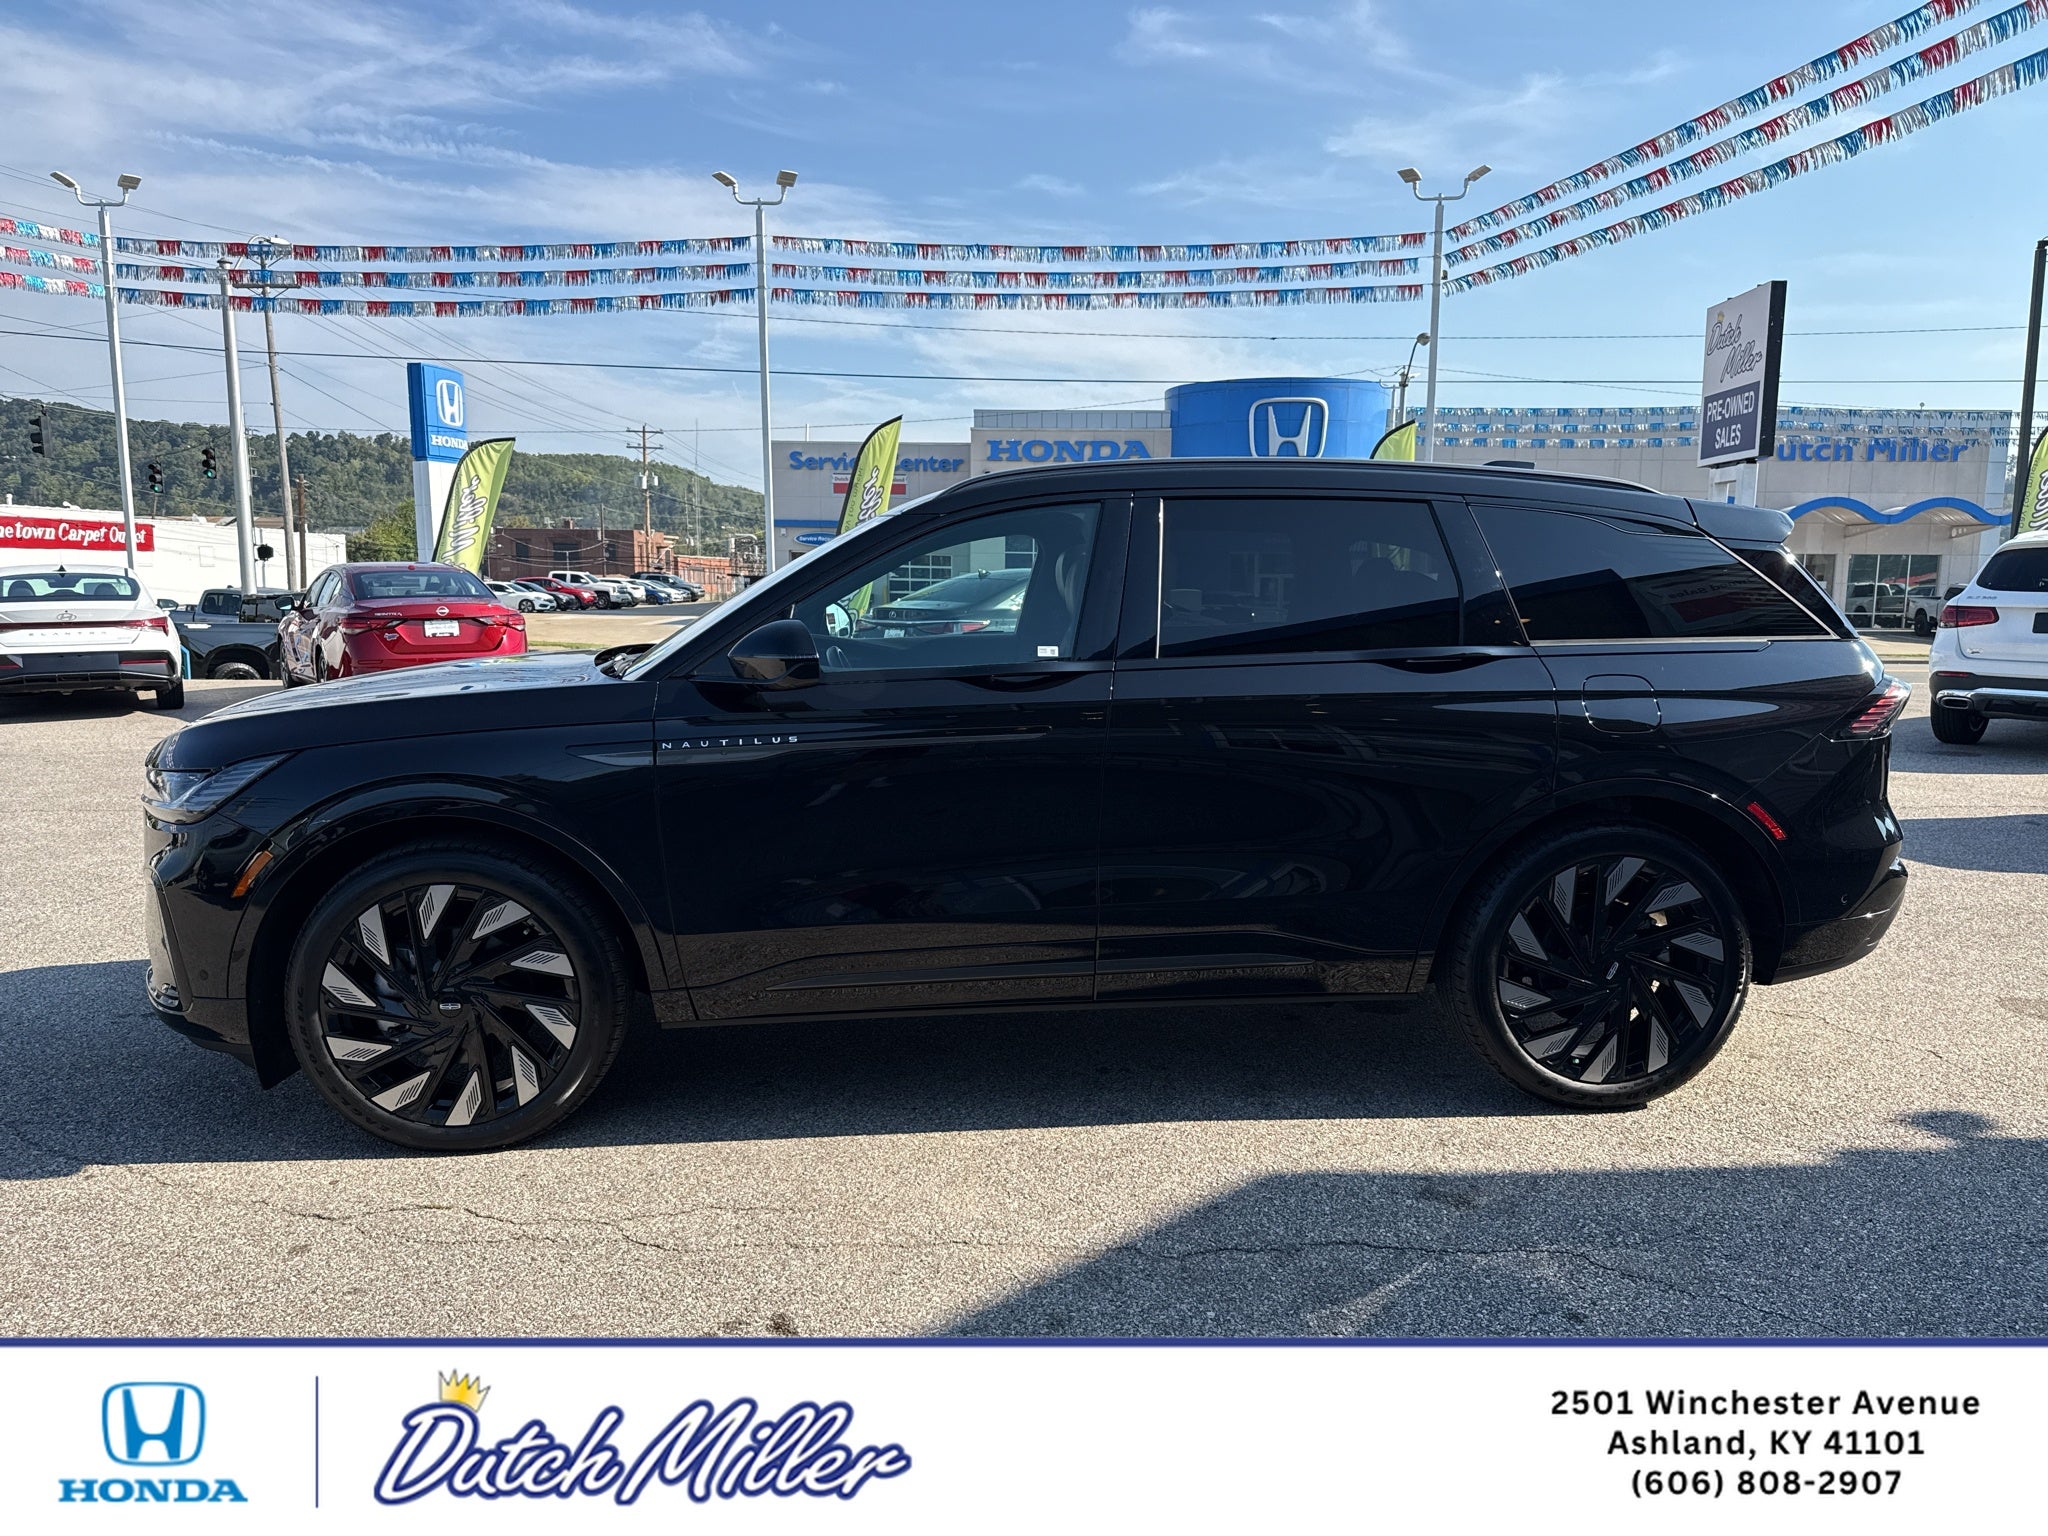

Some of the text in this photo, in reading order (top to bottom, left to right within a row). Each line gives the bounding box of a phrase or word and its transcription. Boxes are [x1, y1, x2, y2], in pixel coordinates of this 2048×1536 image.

[1707, 313, 1743, 356] Dutch
[1720, 339, 1763, 383] Miller
[1706, 390, 1755, 424] PRE-OWNED
[430, 434, 469, 450] HONDA
[1715, 423, 1742, 450] SALES
[788, 450, 965, 472] Servic enter
[986, 439, 1152, 462] HONDA
[1777, 439, 1969, 463] utch Miller
[58, 522, 108, 546] Carpet
[109, 526, 146, 543] Ouet
[662, 735, 798, 750] NAUTILUS
